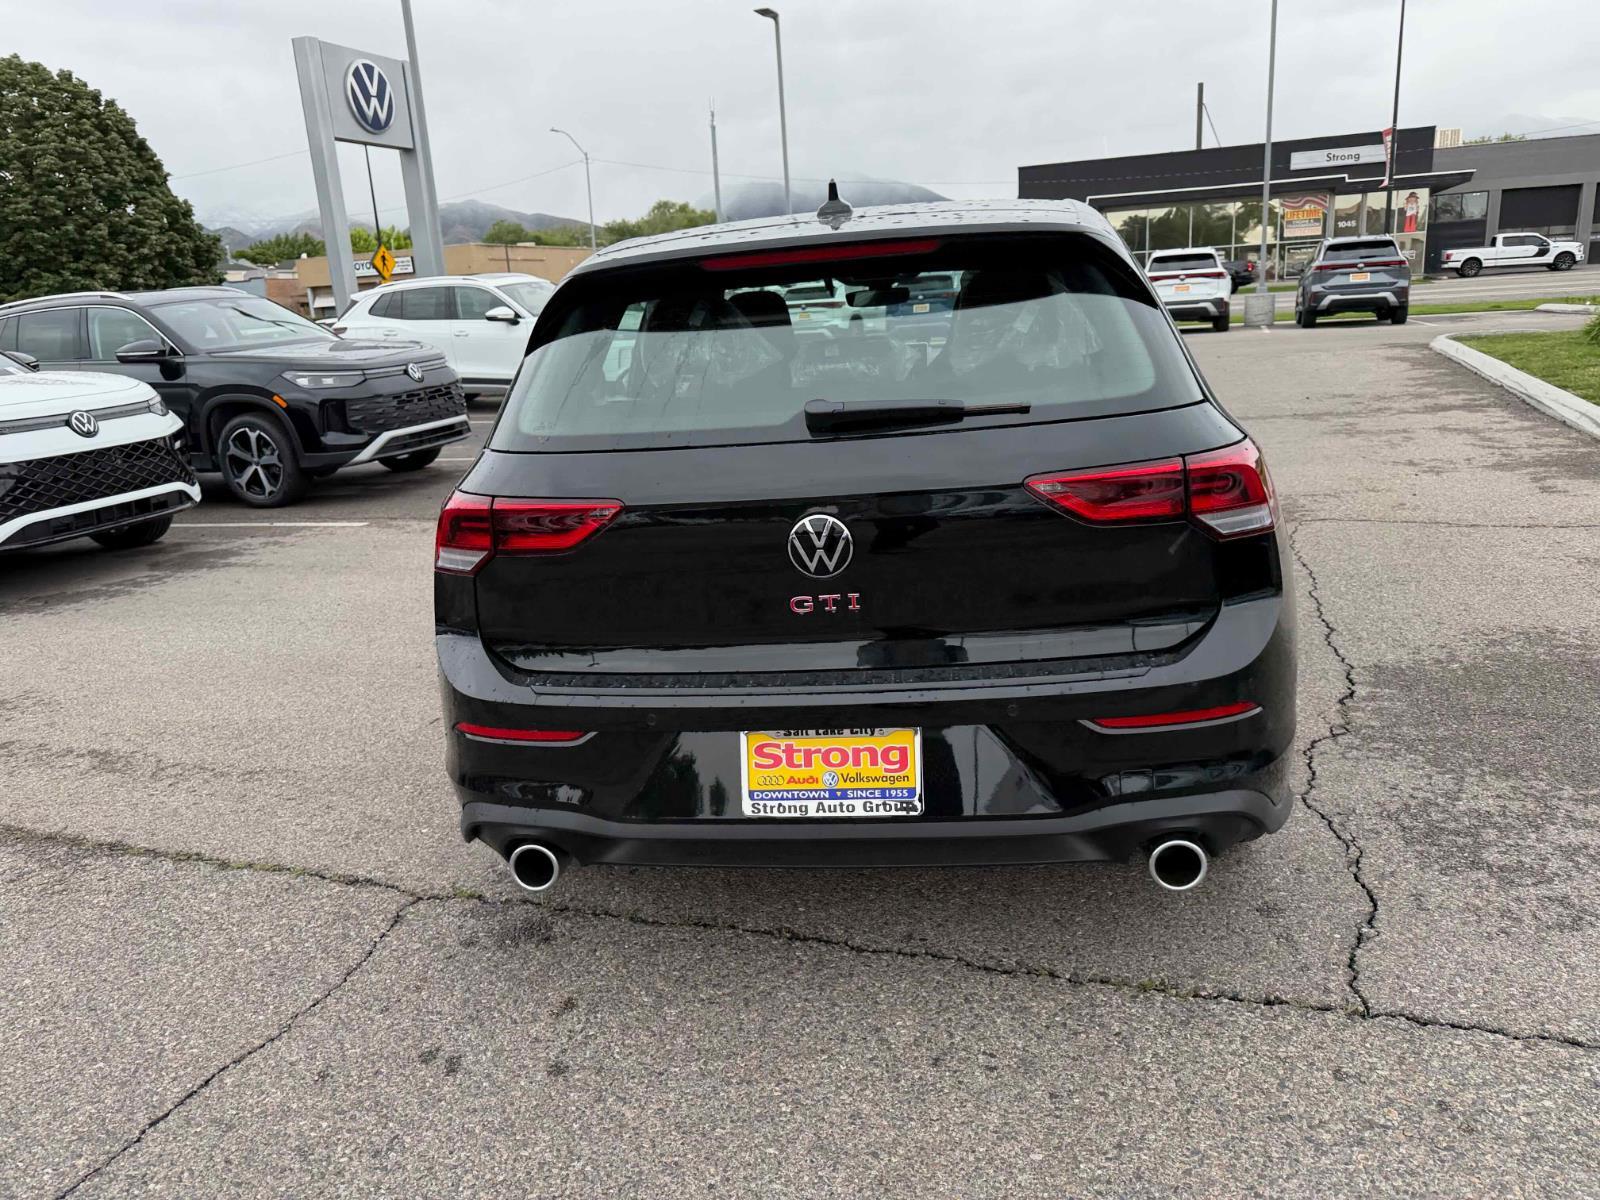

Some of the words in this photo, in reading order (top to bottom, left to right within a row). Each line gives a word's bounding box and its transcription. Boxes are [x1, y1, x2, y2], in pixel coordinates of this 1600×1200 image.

[1326, 152, 1360, 162] Strong
[1337, 220, 1357, 228] 1045
[789, 593, 861, 613] GTI
[753, 742, 909, 773] Strong
[786, 775, 819, 785] Audi
[840, 772, 909, 785] Volkswagen
[753, 790, 829, 800] DOWNTOWN
[847, 789, 882, 798] SINCE
[885, 789, 909, 797] 1955
[751, 802, 809, 816] Strong
[815, 801, 856, 814] Auto
